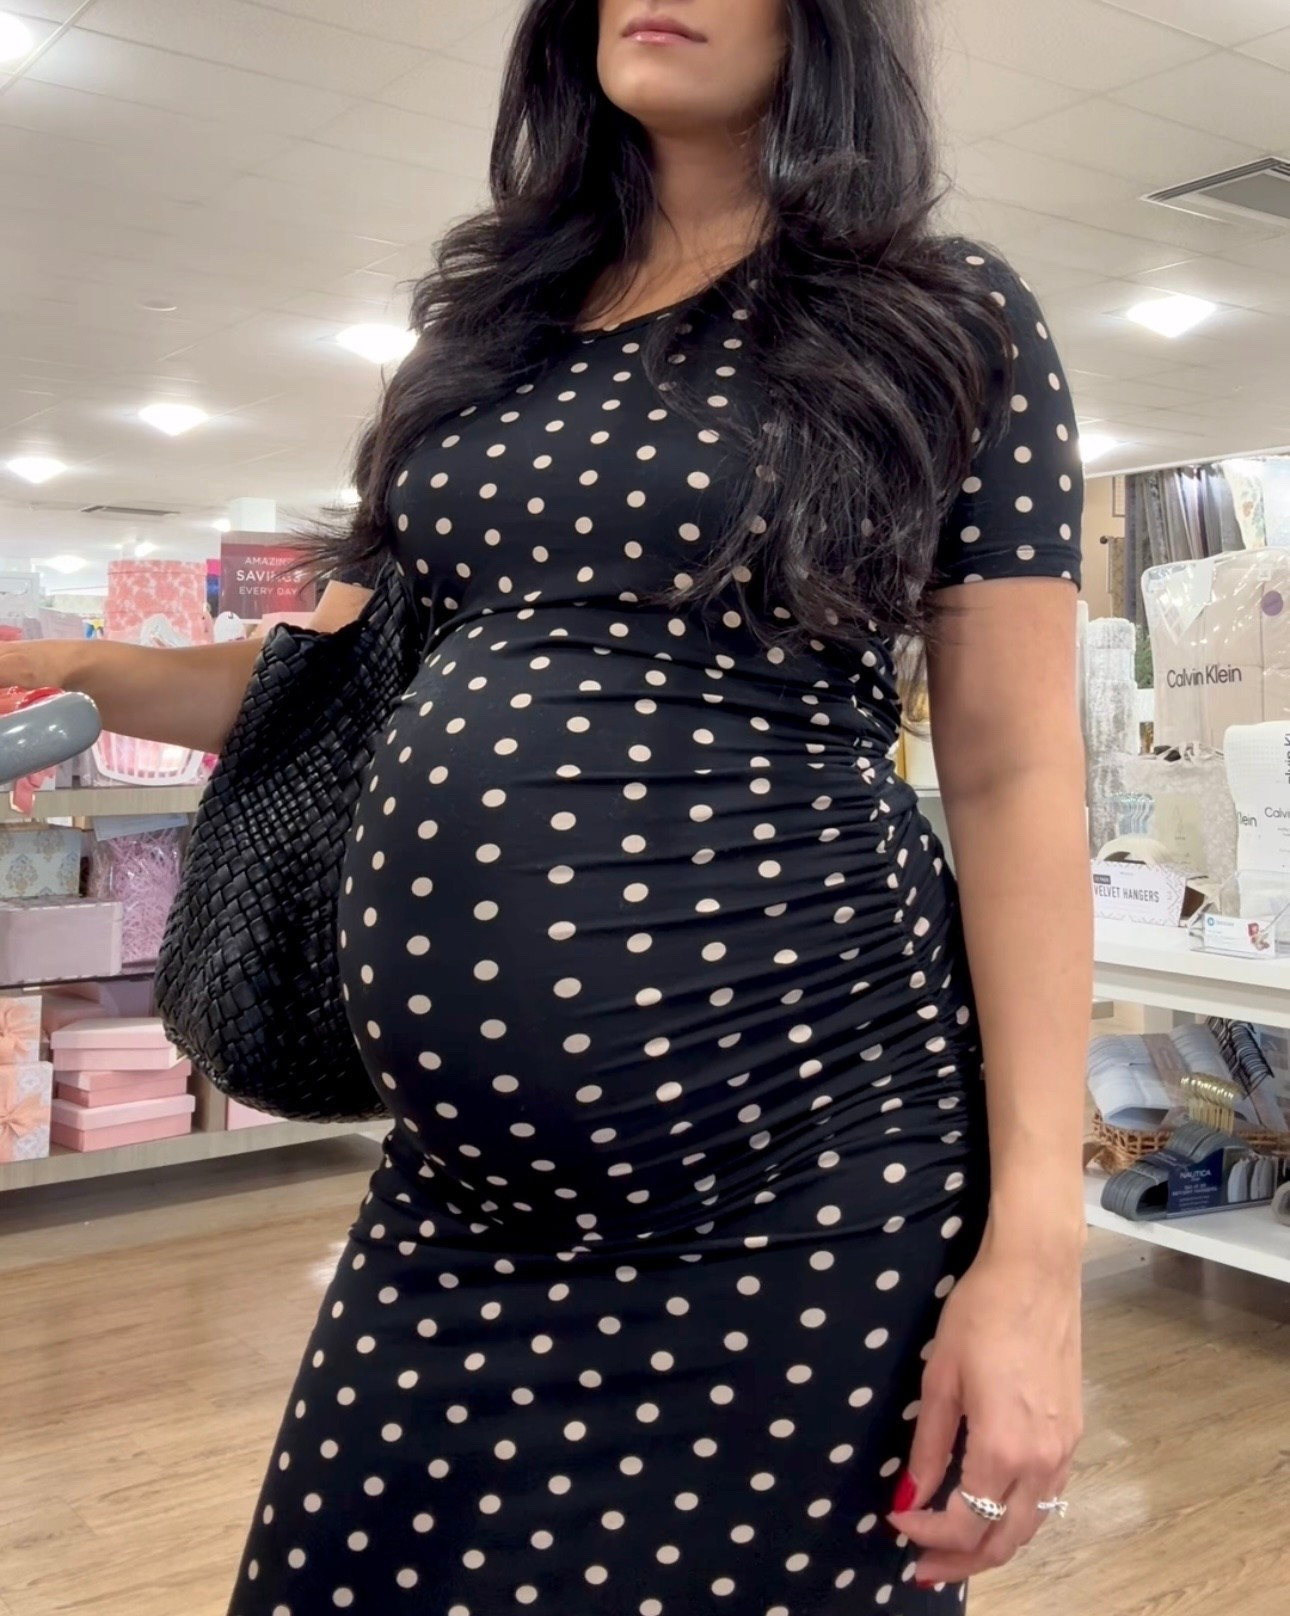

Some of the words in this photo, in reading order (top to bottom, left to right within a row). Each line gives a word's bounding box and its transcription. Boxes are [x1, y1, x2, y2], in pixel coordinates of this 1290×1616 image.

[239, 586, 273, 596] EVERY
[276, 587, 298, 596] DAY
[1166, 668, 1204, 688] Calvin
[1205, 664, 1242, 684] Klein
[1094, 885, 1121, 898] VELVET
[1122, 887, 1160, 903] HANGERS
